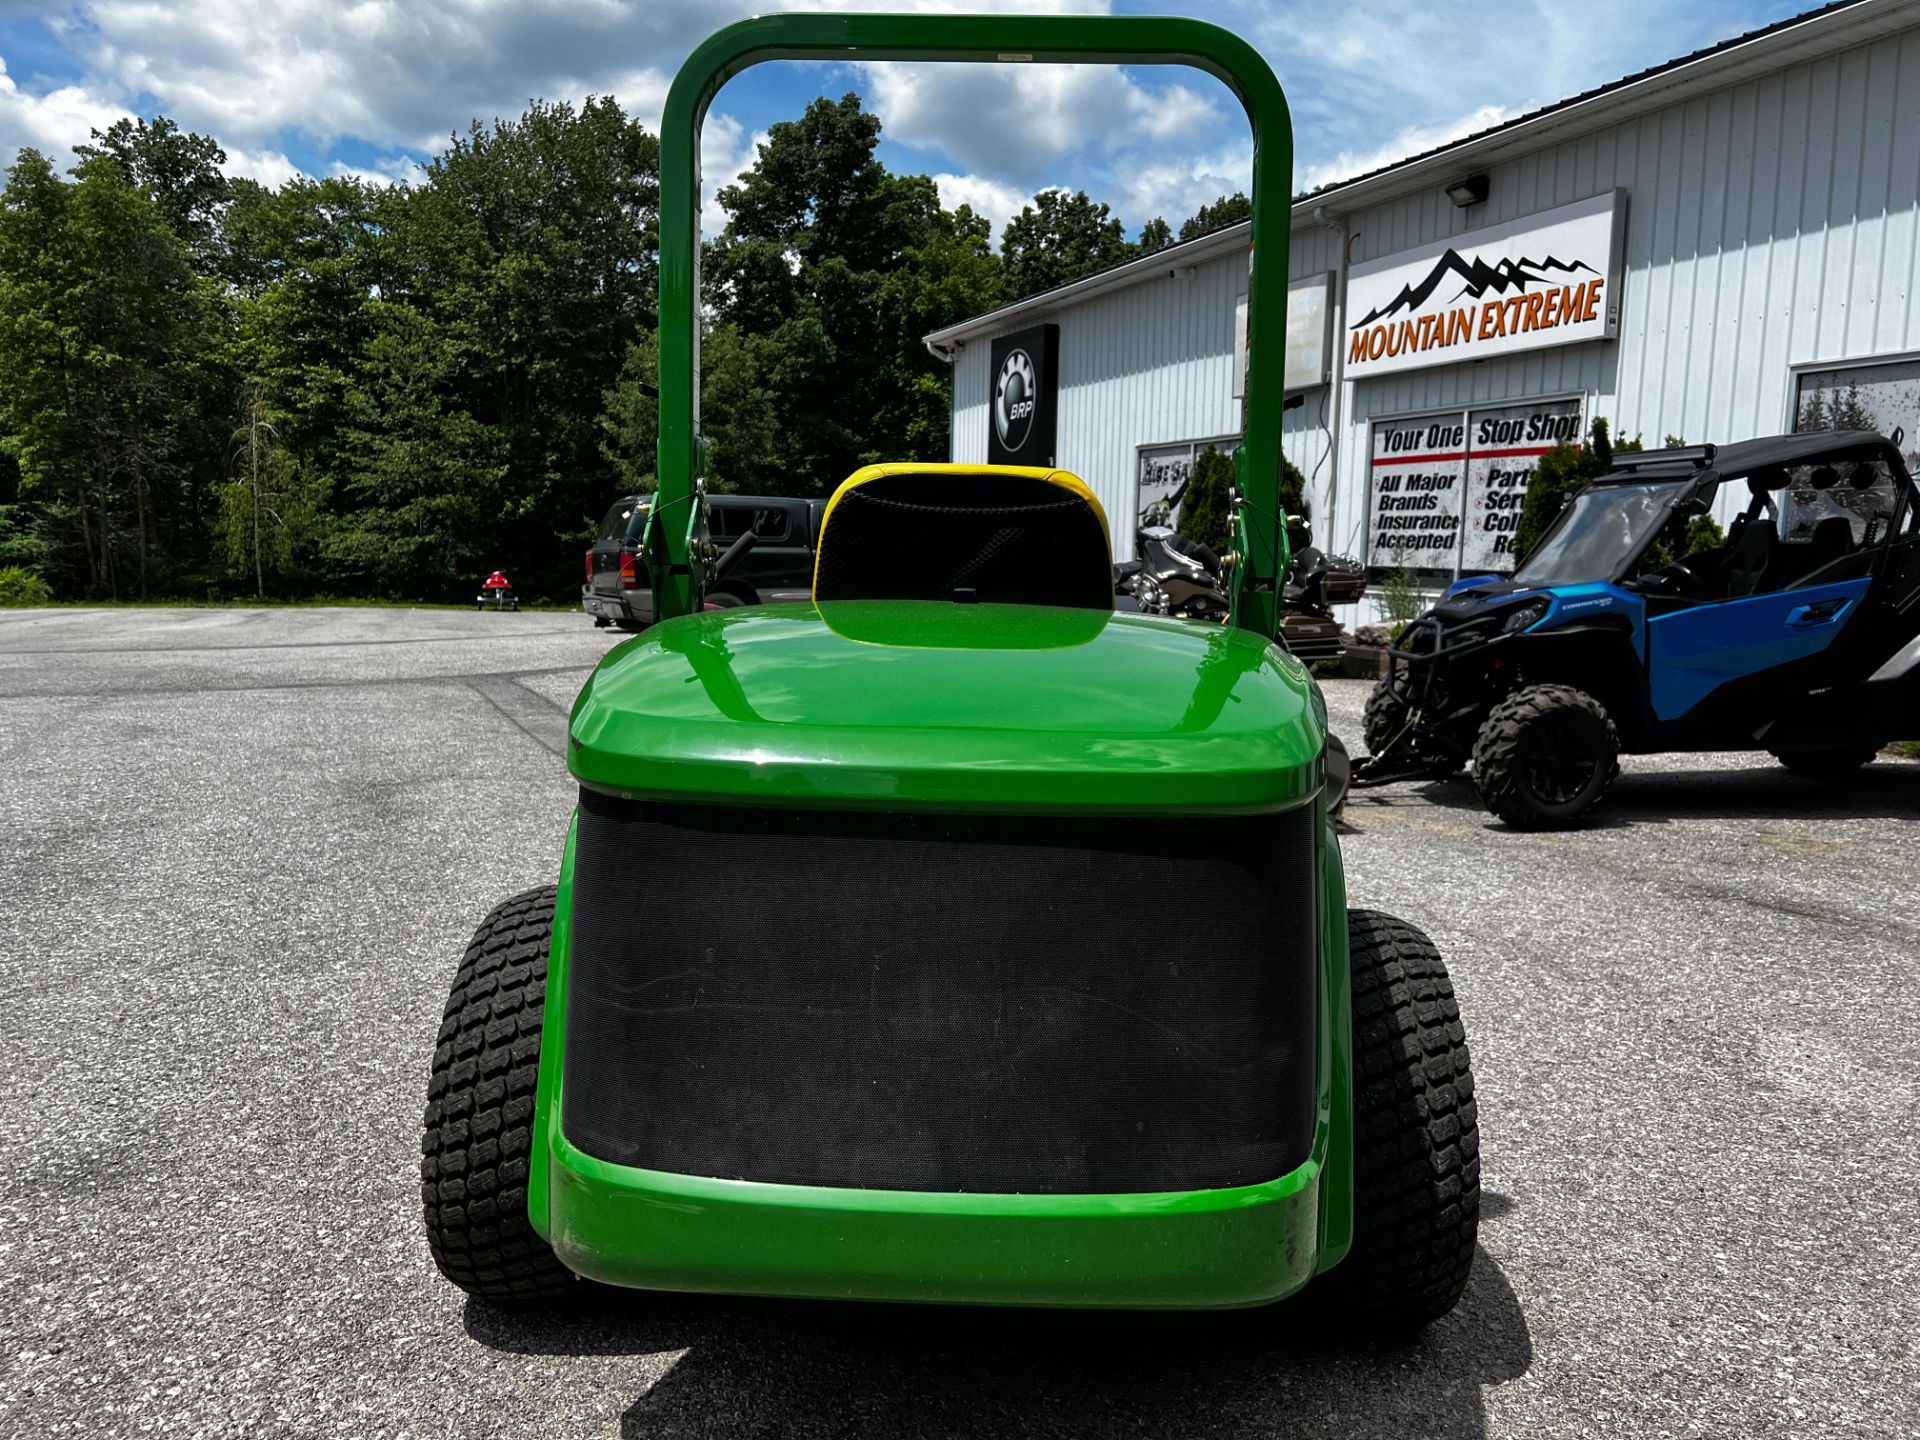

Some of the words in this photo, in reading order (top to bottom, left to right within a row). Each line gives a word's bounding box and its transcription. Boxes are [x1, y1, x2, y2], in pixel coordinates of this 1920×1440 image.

[1349, 305, 1476, 364] MOUNTAIN
[1478, 279, 1604, 340] EXTREME
[1009, 401, 1033, 420] BRP
[1383, 428, 1424, 452] Your
[1426, 424, 1463, 449] One
[1478, 418, 1525, 445] Stop
[1526, 413, 1580, 442] Shop
[1378, 474, 1402, 492] All
[1405, 472, 1457, 492] Major
[1486, 469, 1533, 488] Part
[1378, 493, 1438, 511] Brands
[1377, 513, 1460, 530] Insurance
[1483, 512, 1523, 532] Coll
[1375, 532, 1457, 551] Accepted
[1493, 534, 1517, 553] Re
